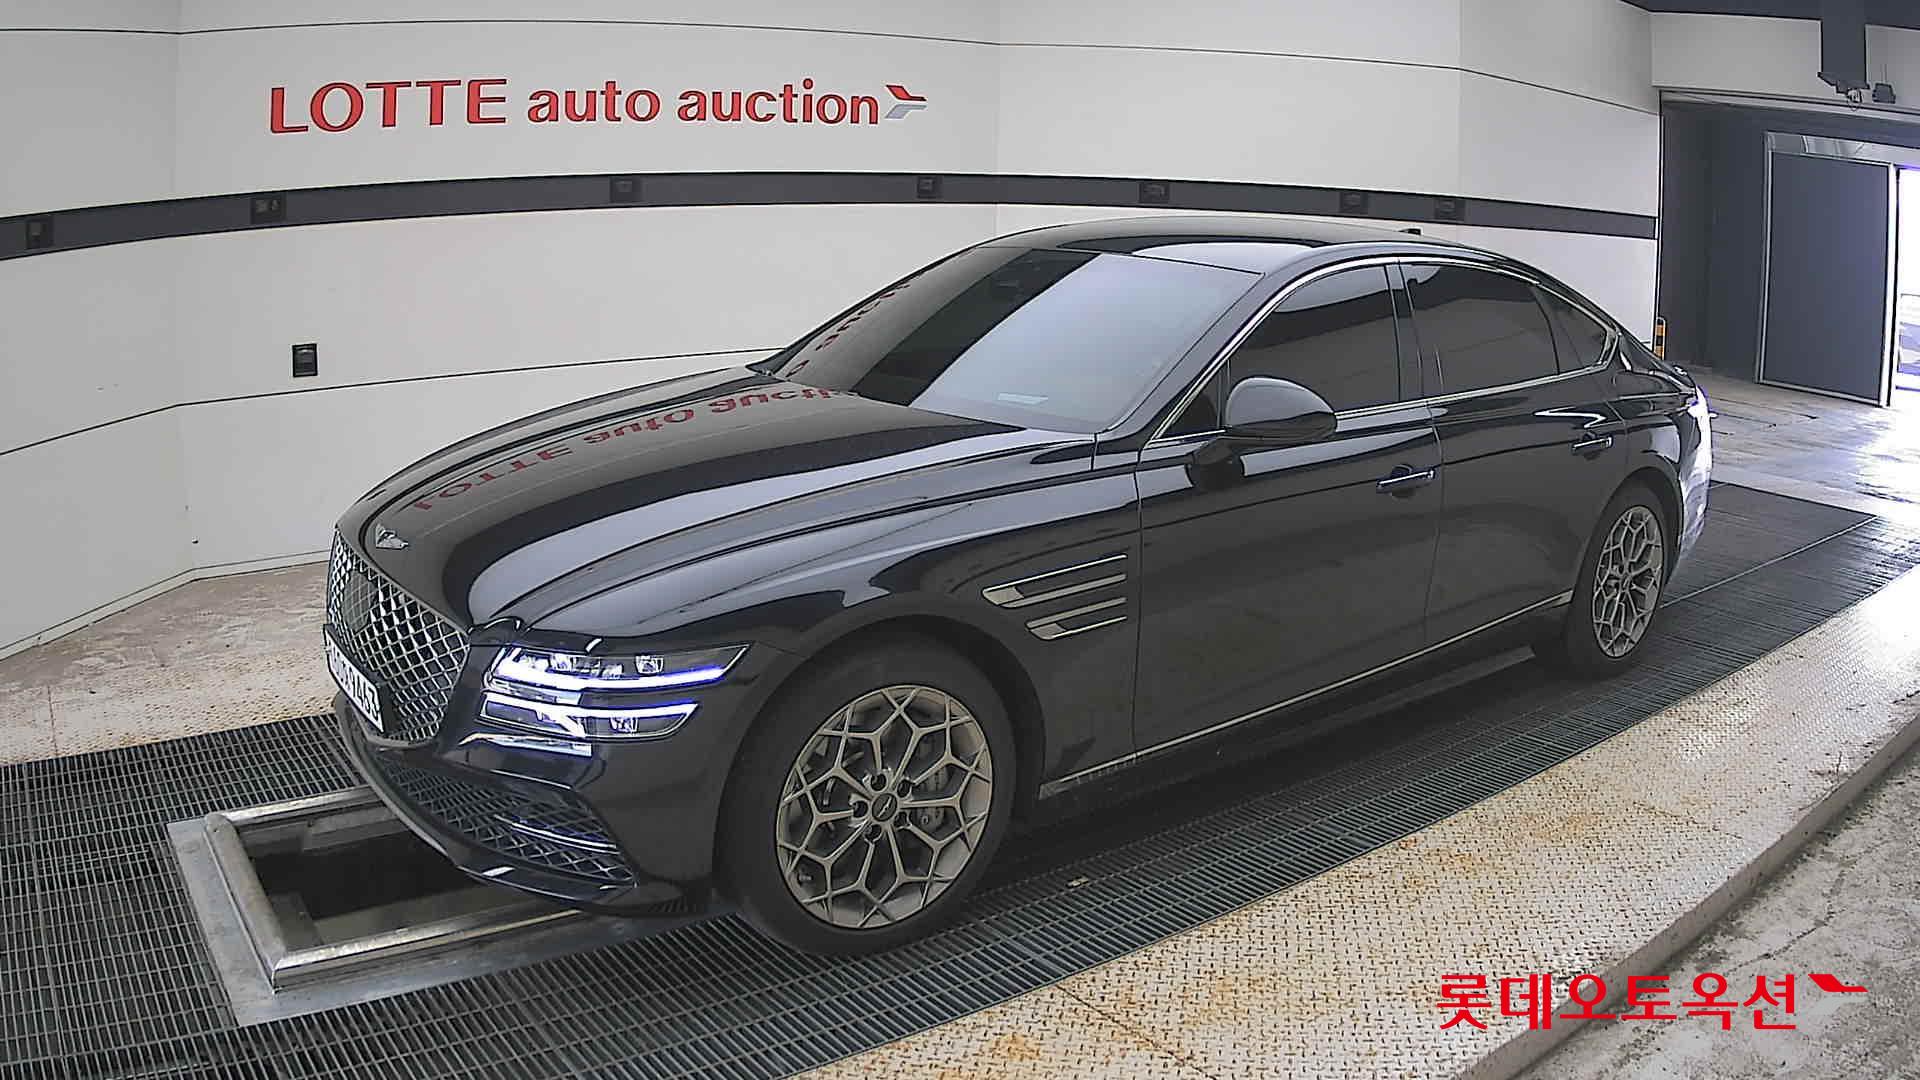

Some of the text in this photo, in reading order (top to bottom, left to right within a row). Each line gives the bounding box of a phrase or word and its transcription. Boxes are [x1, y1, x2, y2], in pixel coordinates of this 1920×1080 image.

[270, 78, 880, 135] LOTTE auto auction
